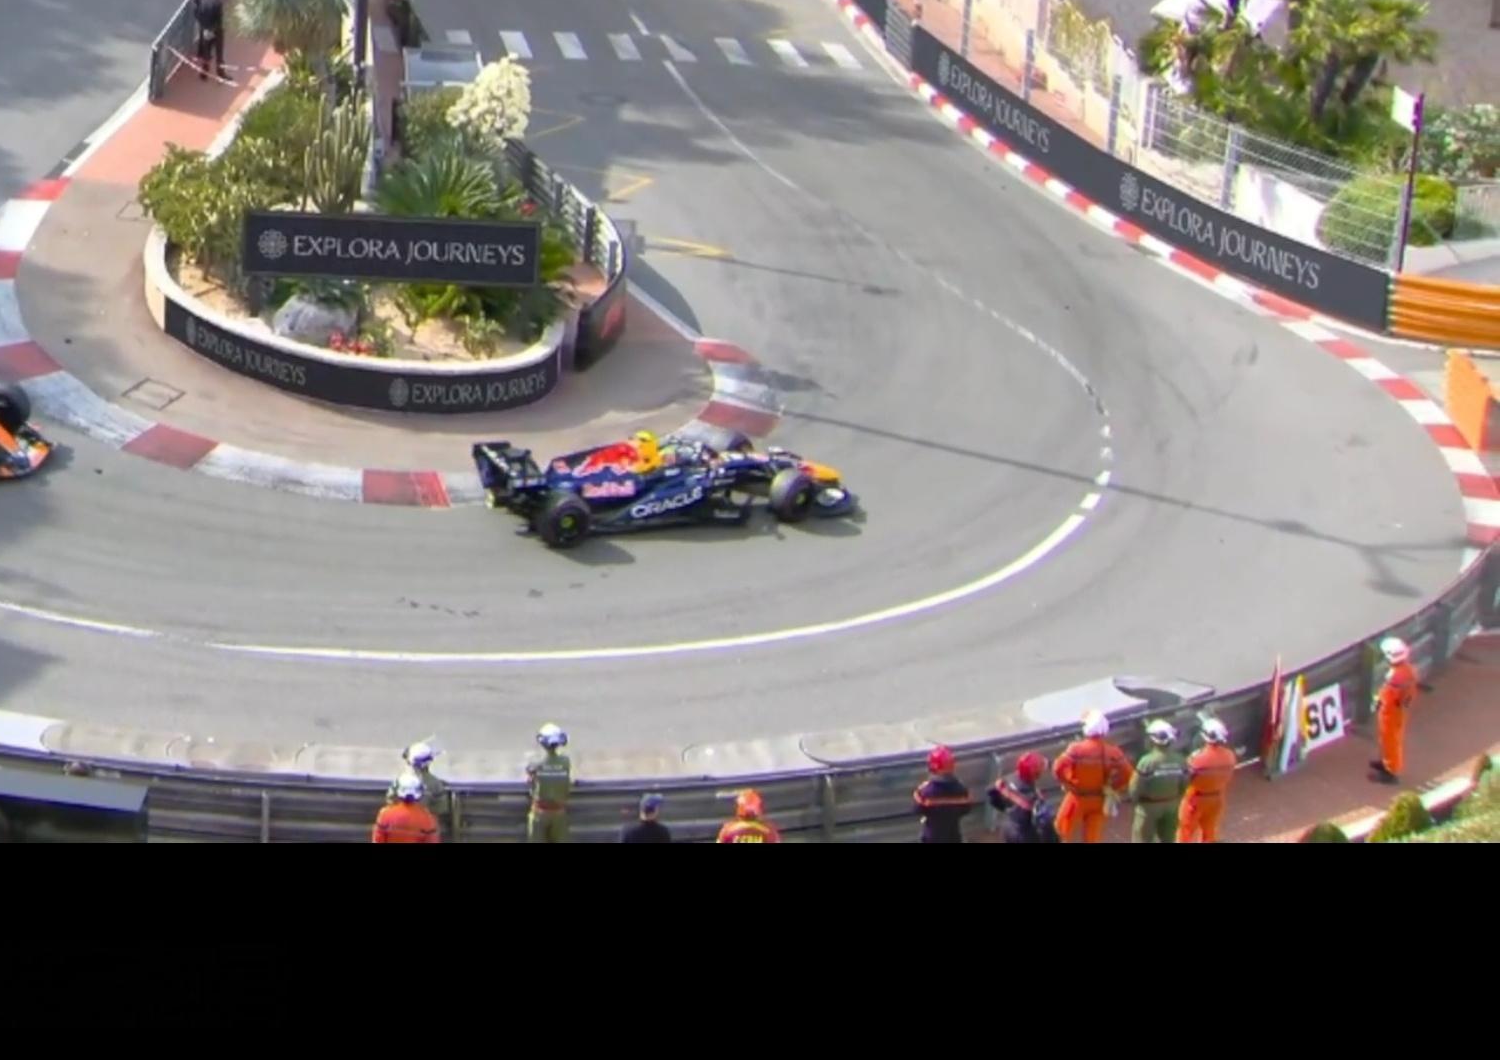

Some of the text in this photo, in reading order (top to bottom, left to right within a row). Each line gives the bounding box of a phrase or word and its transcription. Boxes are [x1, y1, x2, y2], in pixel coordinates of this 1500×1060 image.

[293, 234, 527, 267] EXPLORA JOURNEYS
[1140, 187, 1322, 290] EXPLORA JOURNEYS
[195, 325, 243, 365] EXPLORA
[411, 369, 547, 407] EXPLORA JOURNEYS
[630, 485, 704, 520] ORACLE
[1304, 695, 1337, 741] SC
